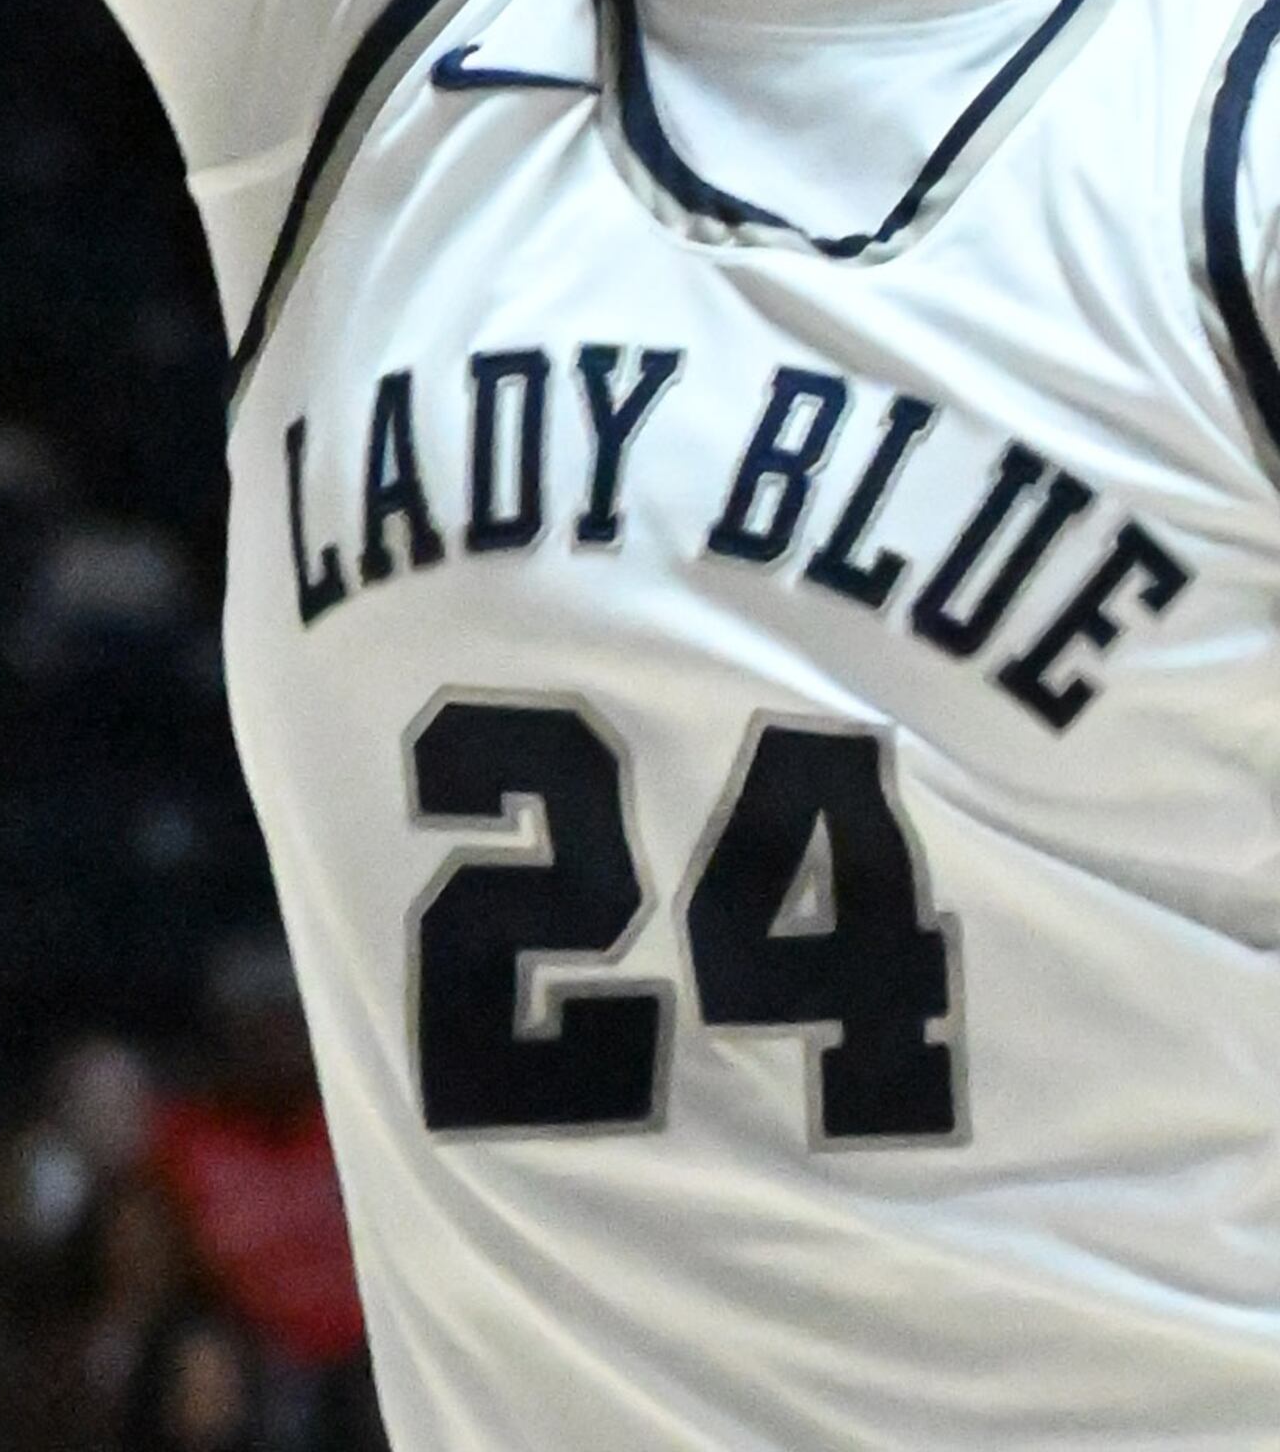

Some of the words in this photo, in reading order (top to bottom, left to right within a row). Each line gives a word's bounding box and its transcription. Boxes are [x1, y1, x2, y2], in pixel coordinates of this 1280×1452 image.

[284, 342, 687, 629] LADY
[705, 363, 1198, 738] BLUE
[401, 682, 972, 1152] 24
